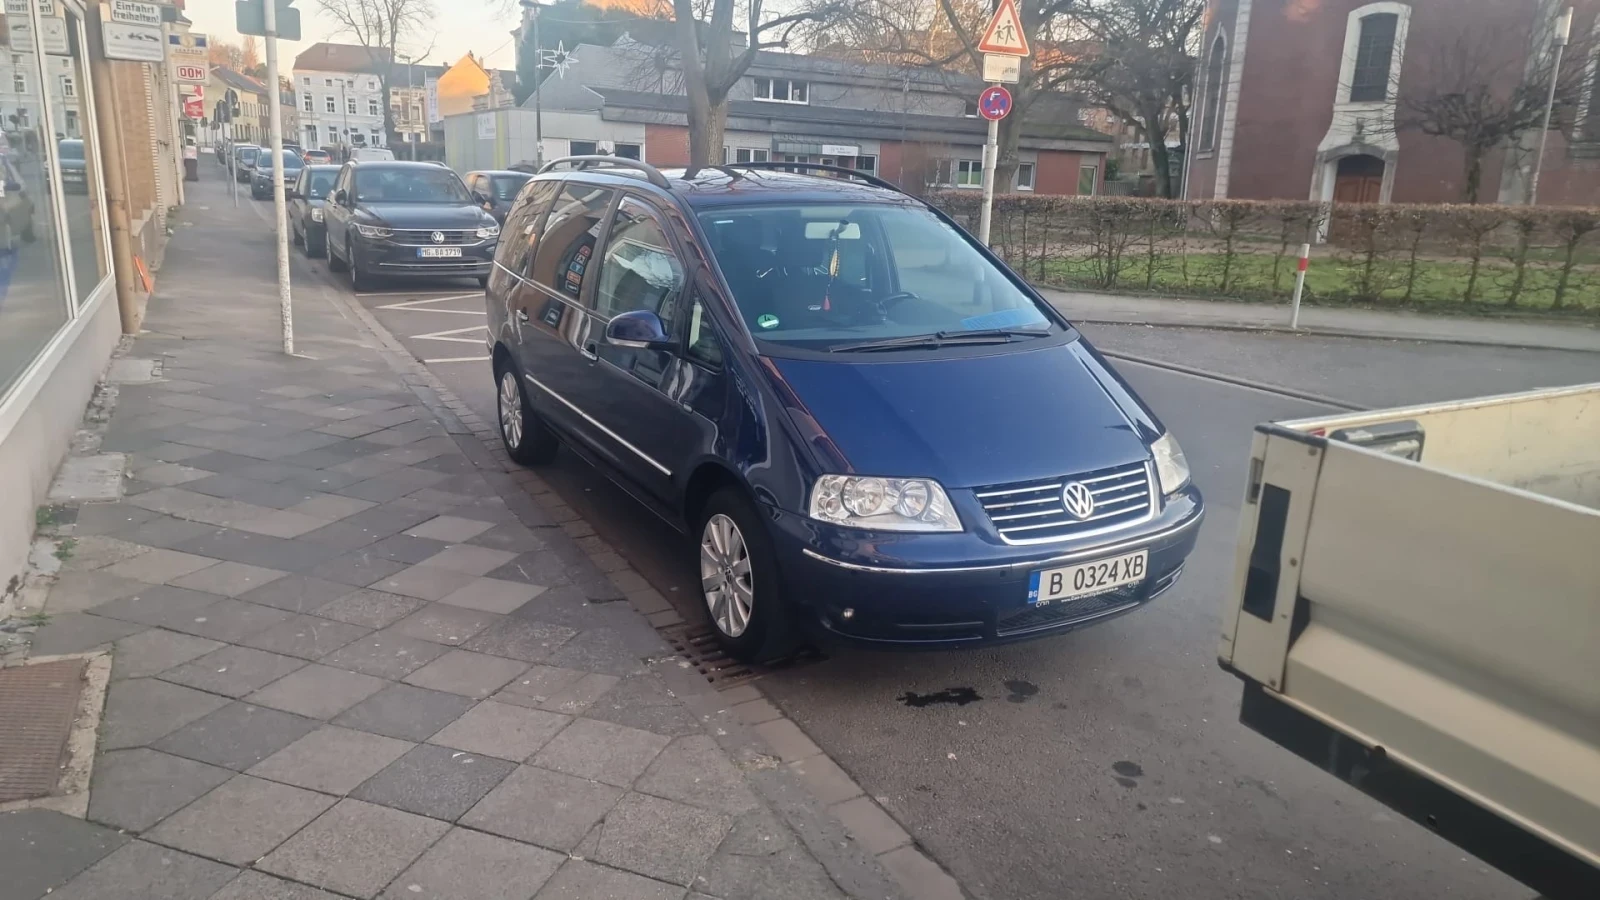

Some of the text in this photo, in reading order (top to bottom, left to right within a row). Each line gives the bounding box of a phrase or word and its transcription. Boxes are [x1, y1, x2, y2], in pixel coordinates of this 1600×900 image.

[115, 0, 155, 14] Einfahrt
[113, 9, 160, 24] freihalten!
[179, 67, 203, 79] DOM
[1049, 554, 1144, 596] B 0324 XB
[1028, 590, 1038, 599] BG
